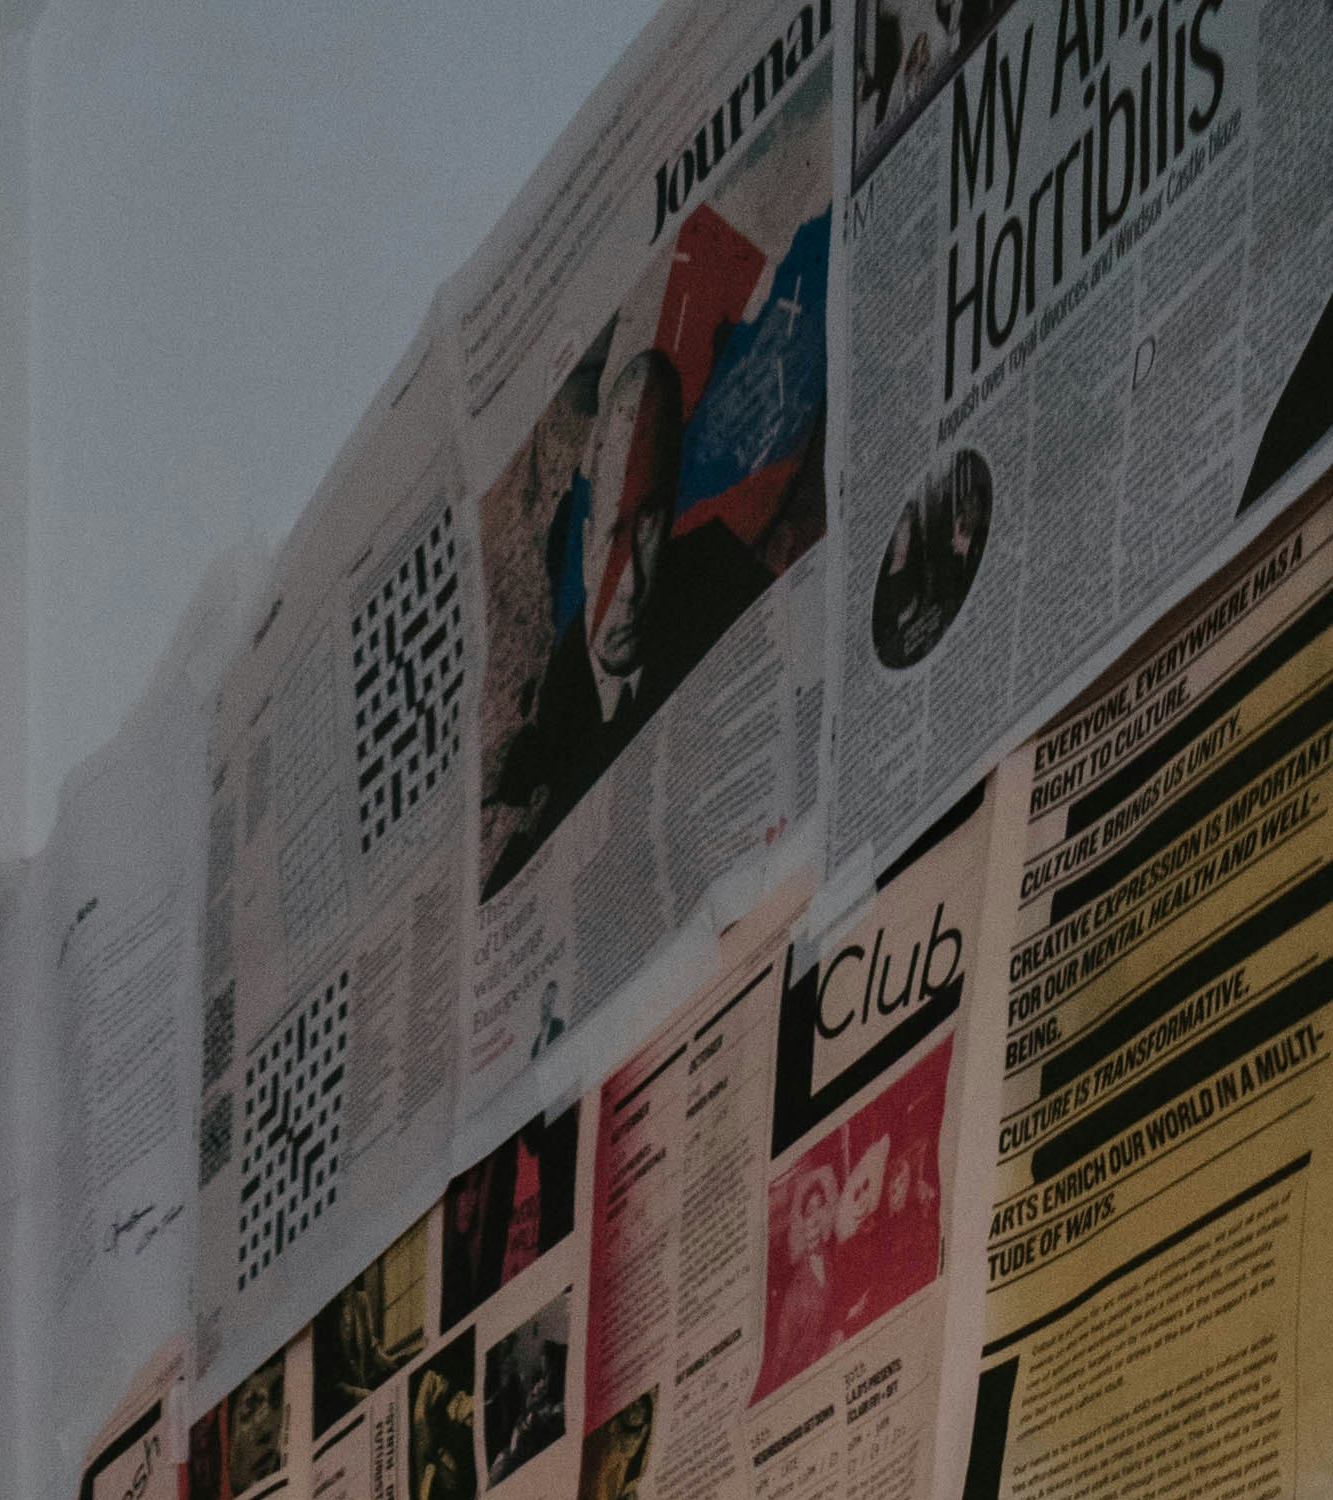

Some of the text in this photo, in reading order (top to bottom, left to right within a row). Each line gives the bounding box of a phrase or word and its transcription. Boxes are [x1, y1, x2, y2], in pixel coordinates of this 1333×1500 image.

[649, 0, 832, 246] Journal
[944, 0, 1225, 401] Horribilis
[950, 22, 1034, 233] My
[1034, 533, 1304, 771] EVERYONE, EVERYWHERE HAS A
[1009, 733, 1333, 984] CREATIVE EXPRESSION IS IMPORTANT
[1020, 707, 1242, 900] CULTURE BRINGS US UNITY.
[1030, 754, 1088, 817] RIGHT
[1088, 740, 1112, 778] TO
[815, 903, 963, 1040] Club
[1008, 790, 1320, 1028] FOR OUR MENTAL HEALTH AND WELL-
[988, 1021, 1325, 1241] ARTS ENRICH OUR WORLD IN A MULTI-
[998, 966, 1251, 1155] CULTURE IS TRANSFORMATIVE.
[1004, 1015, 1063, 1072] BEING.
[987, 1192, 1117, 1281] TUDE OF WAYS.
